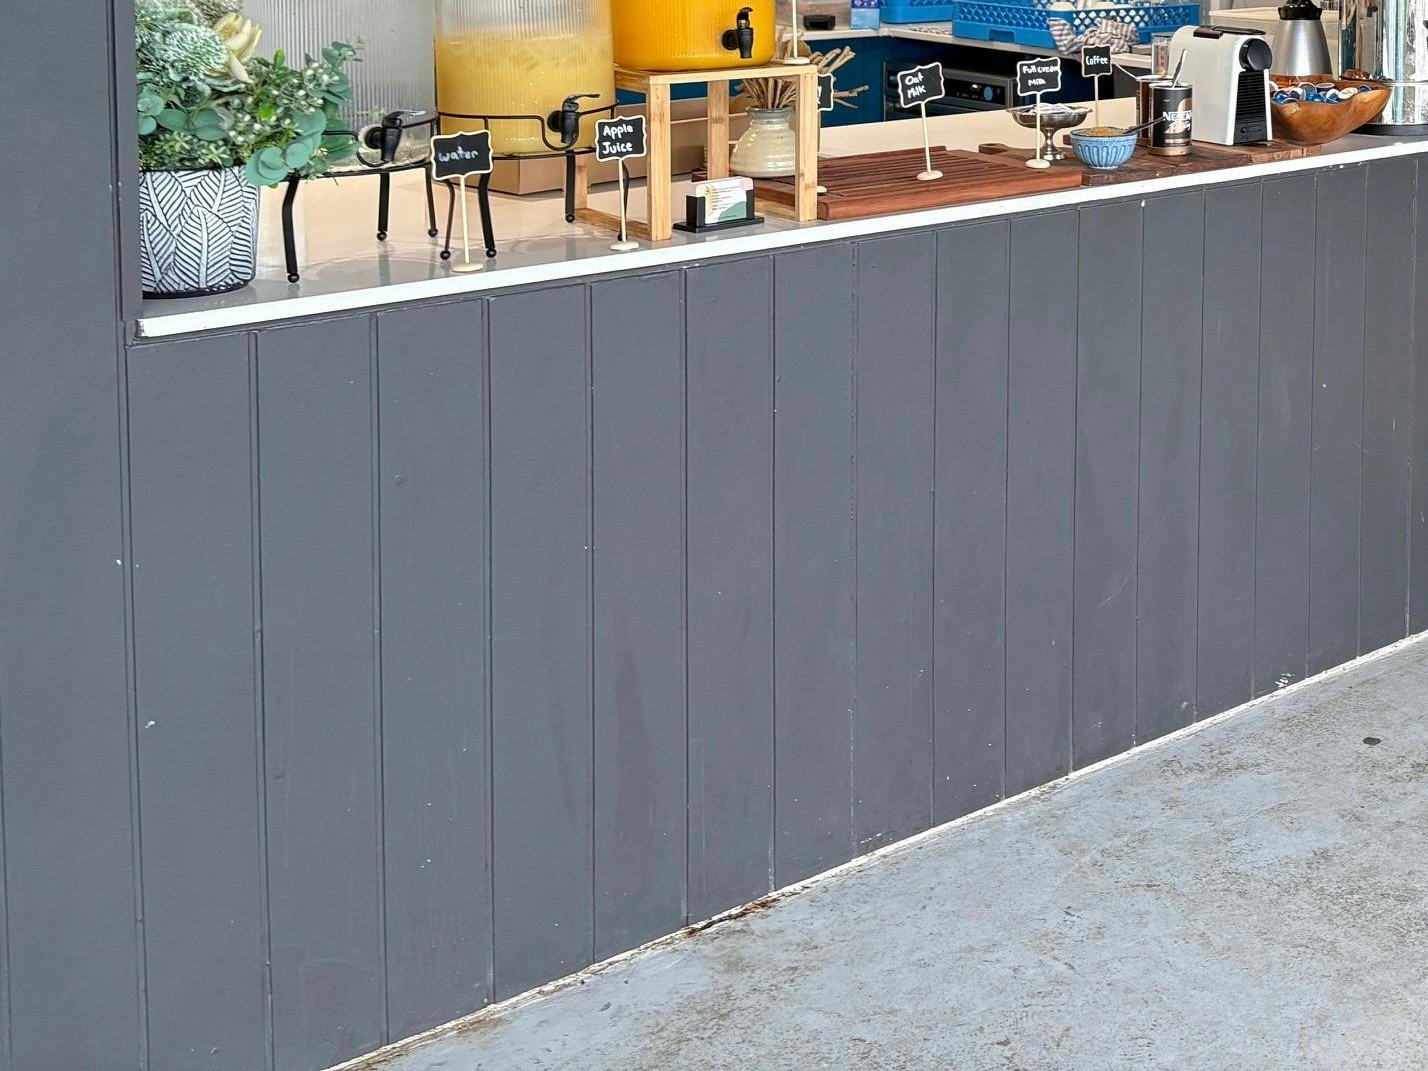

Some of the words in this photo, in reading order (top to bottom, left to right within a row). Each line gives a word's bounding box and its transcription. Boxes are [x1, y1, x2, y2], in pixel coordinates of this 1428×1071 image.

[1085, 55, 1108, 66] Coffee
[1022, 65, 1037, 74] Full
[905, 72, 924, 86] Oat
[907, 84, 927, 99] Milk
[603, 123, 634, 140] Apple
[438, 145, 479, 162] water
[602, 141, 633, 155] Juice
